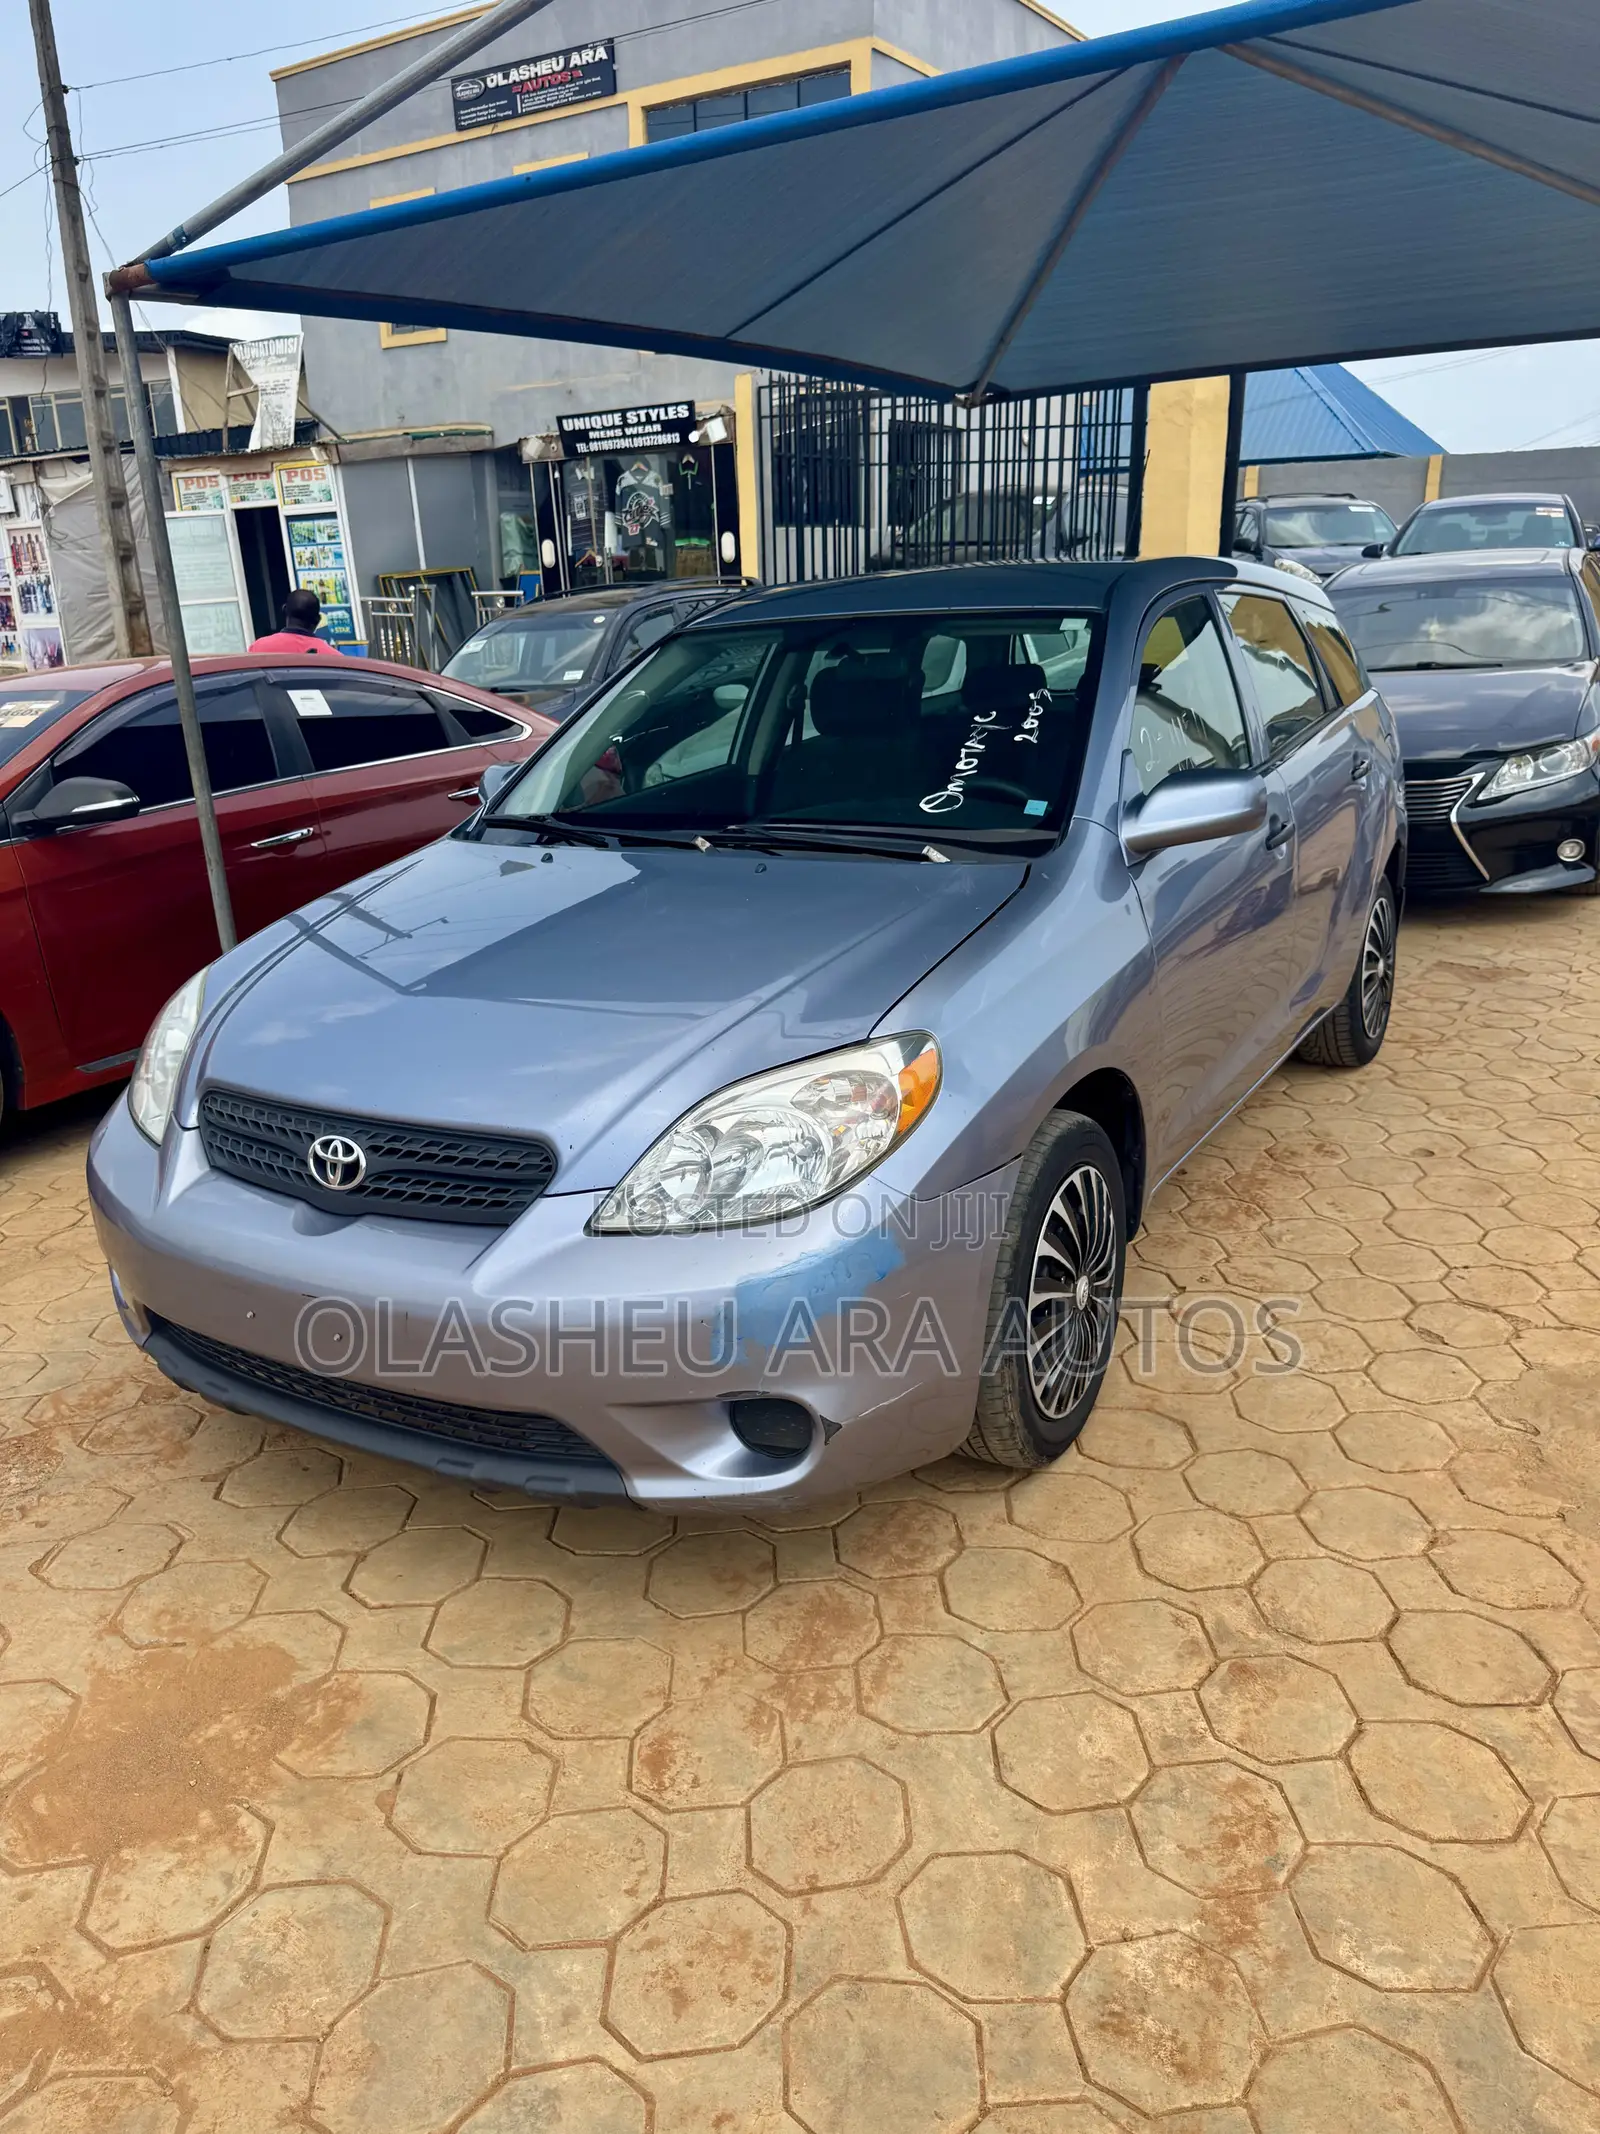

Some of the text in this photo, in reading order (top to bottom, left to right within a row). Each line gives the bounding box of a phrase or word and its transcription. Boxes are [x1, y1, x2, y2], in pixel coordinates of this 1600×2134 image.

[486, 56, 566, 89] OLASHEU
[569, 46, 609, 68] ARA
[521, 72, 572, 93] AUTOS
[562, 404, 690, 431] UNIQUE STYLES
[588, 424, 662, 439] MENS WEAR
[183, 475, 220, 490] POS
[232, 471, 271, 482] POS
[285, 467, 327, 483] POS
